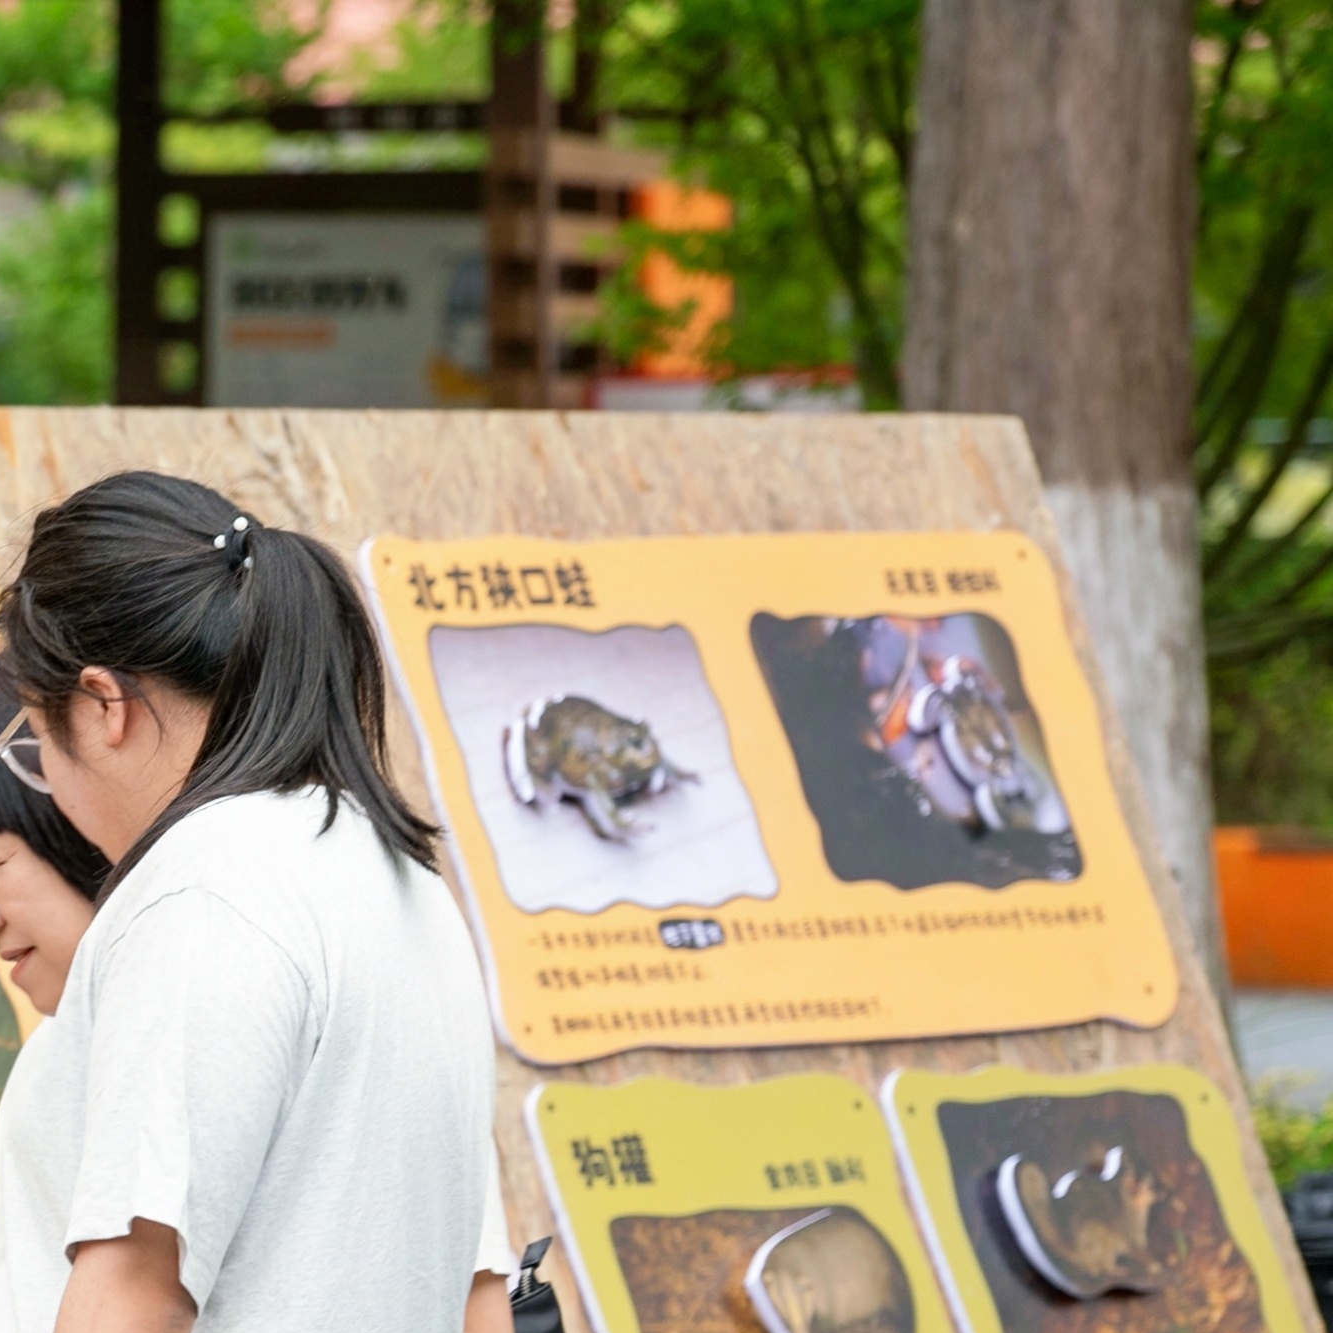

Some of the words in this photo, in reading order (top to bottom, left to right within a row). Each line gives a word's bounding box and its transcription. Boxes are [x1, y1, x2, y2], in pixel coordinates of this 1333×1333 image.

[409, 561, 597, 611] 北方狭口蛙
[570, 1133, 655, 1188] 狗獾
